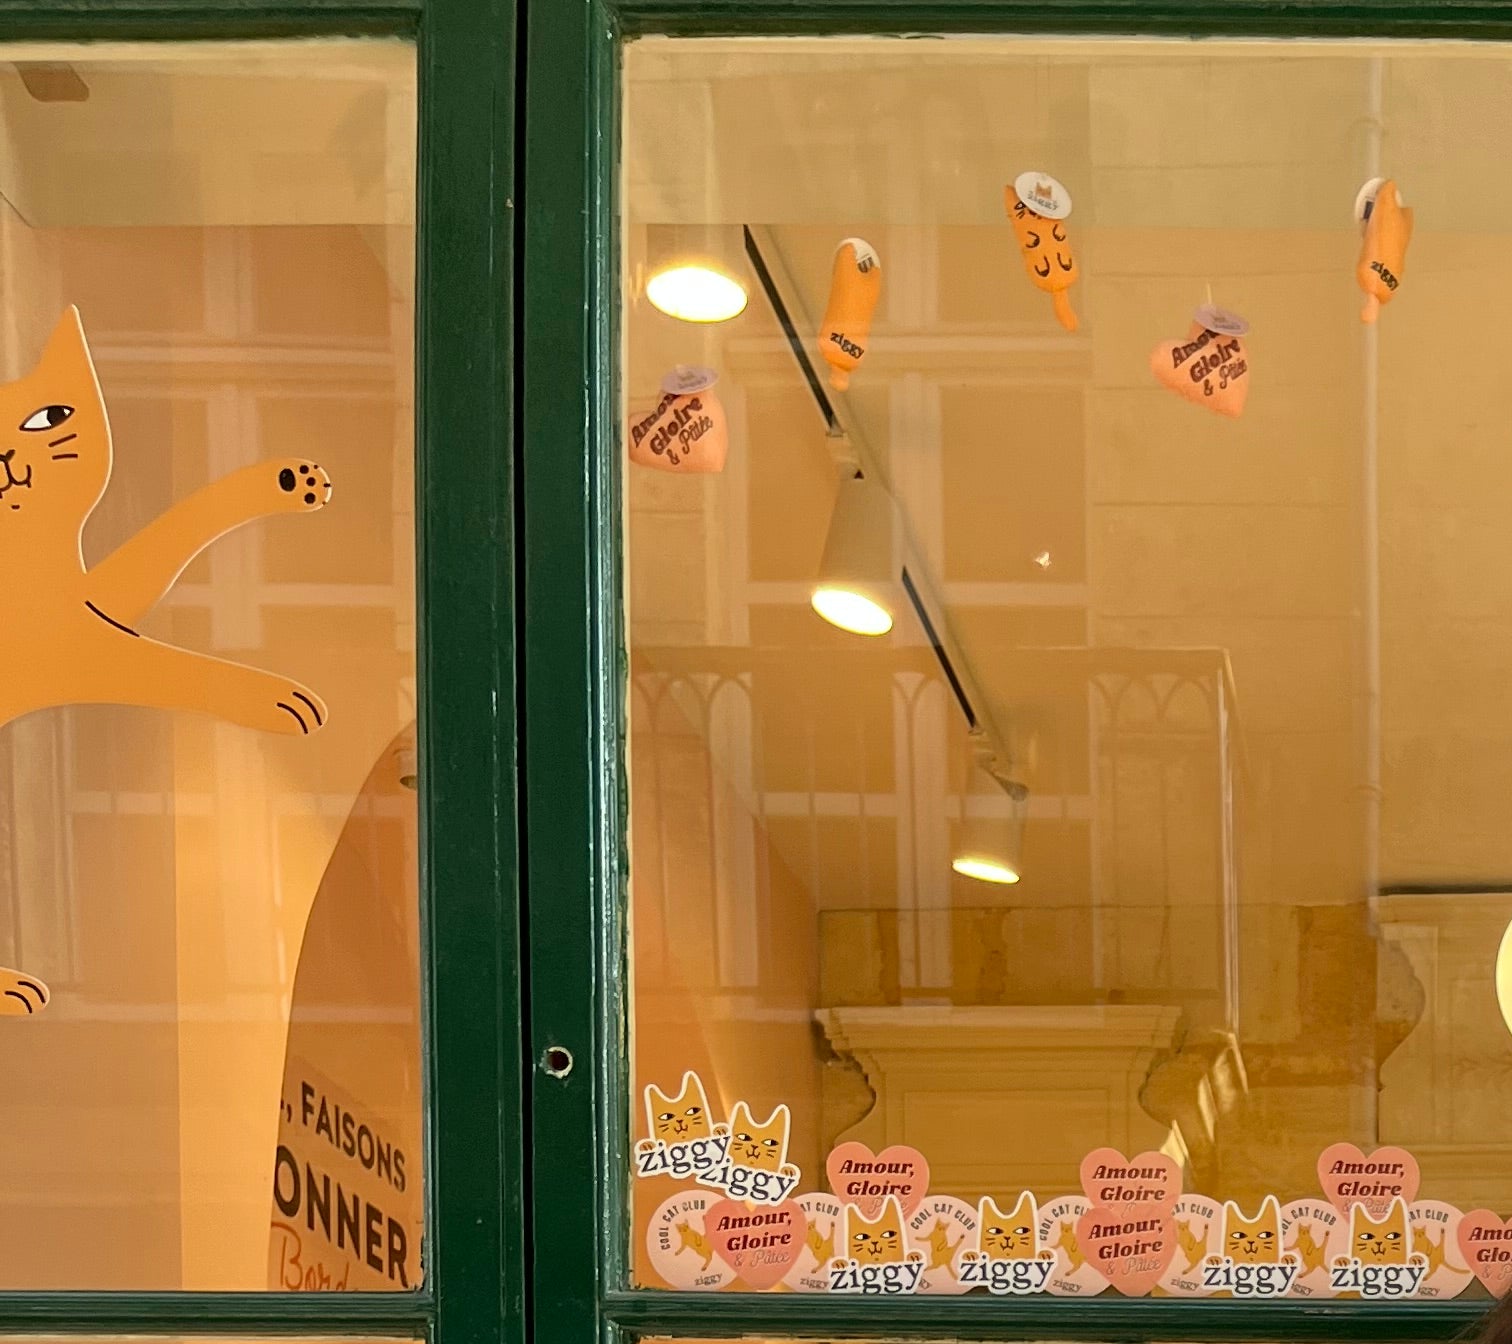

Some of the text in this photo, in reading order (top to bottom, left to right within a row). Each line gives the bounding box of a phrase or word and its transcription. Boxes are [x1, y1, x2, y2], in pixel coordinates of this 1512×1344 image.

[830, 332, 864, 360] ziggy
[649, 397, 703, 455] Gloire
[301, 1080, 406, 1192] FAISONS
[639, 1135, 731, 1174] ziggy
[839, 1159, 915, 1179] Amour,
[1092, 1165, 1168, 1183] Amour,
[1329, 1160, 1405, 1179] Amour,
[699, 1158, 795, 1202] ziggy
[847, 1180, 912, 1197] Gloire
[1337, 1181, 1402, 1198] Gloire
[1100, 1185, 1165, 1202] Gloire
[273, 1144, 408, 1288] ONNER
[910, 1209, 932, 1230] COOL
[934, 1203, 952, 1214] CAT
[954, 1209, 977, 1231] CLUB
[1190, 1203, 1214, 1219] CLUB
[1290, 1206, 1310, 1220] CAT
[1313, 1208, 1337, 1226] CLUB
[1425, 1209, 1449, 1223] CLUB
[658, 1200, 706, 1250] COOL CAT CLUB
[716, 1211, 793, 1232] Amour,
[1039, 1217, 1054, 1241] COOL
[1052, 1204, 1070, 1219] CAT
[1088, 1218, 1164, 1240] Amour,
[727, 1232, 792, 1251] Gloire
[1099, 1240, 1164, 1260] Gloire
[734, 1253, 743, 1267] &
[1105, 1262, 1116, 1276] &
[694, 1273, 723, 1287] ziggy
[831, 1261, 924, 1294] ziggy
[960, 1254, 1055, 1290] ziggy
[1204, 1259, 1298, 1294] ziggy
[1332, 1260, 1425, 1296] ziggy
[800, 1277, 830, 1290] ziggy
[1053, 1279, 1083, 1293] ziggy
[1170, 1278, 1200, 1292] ziggy
